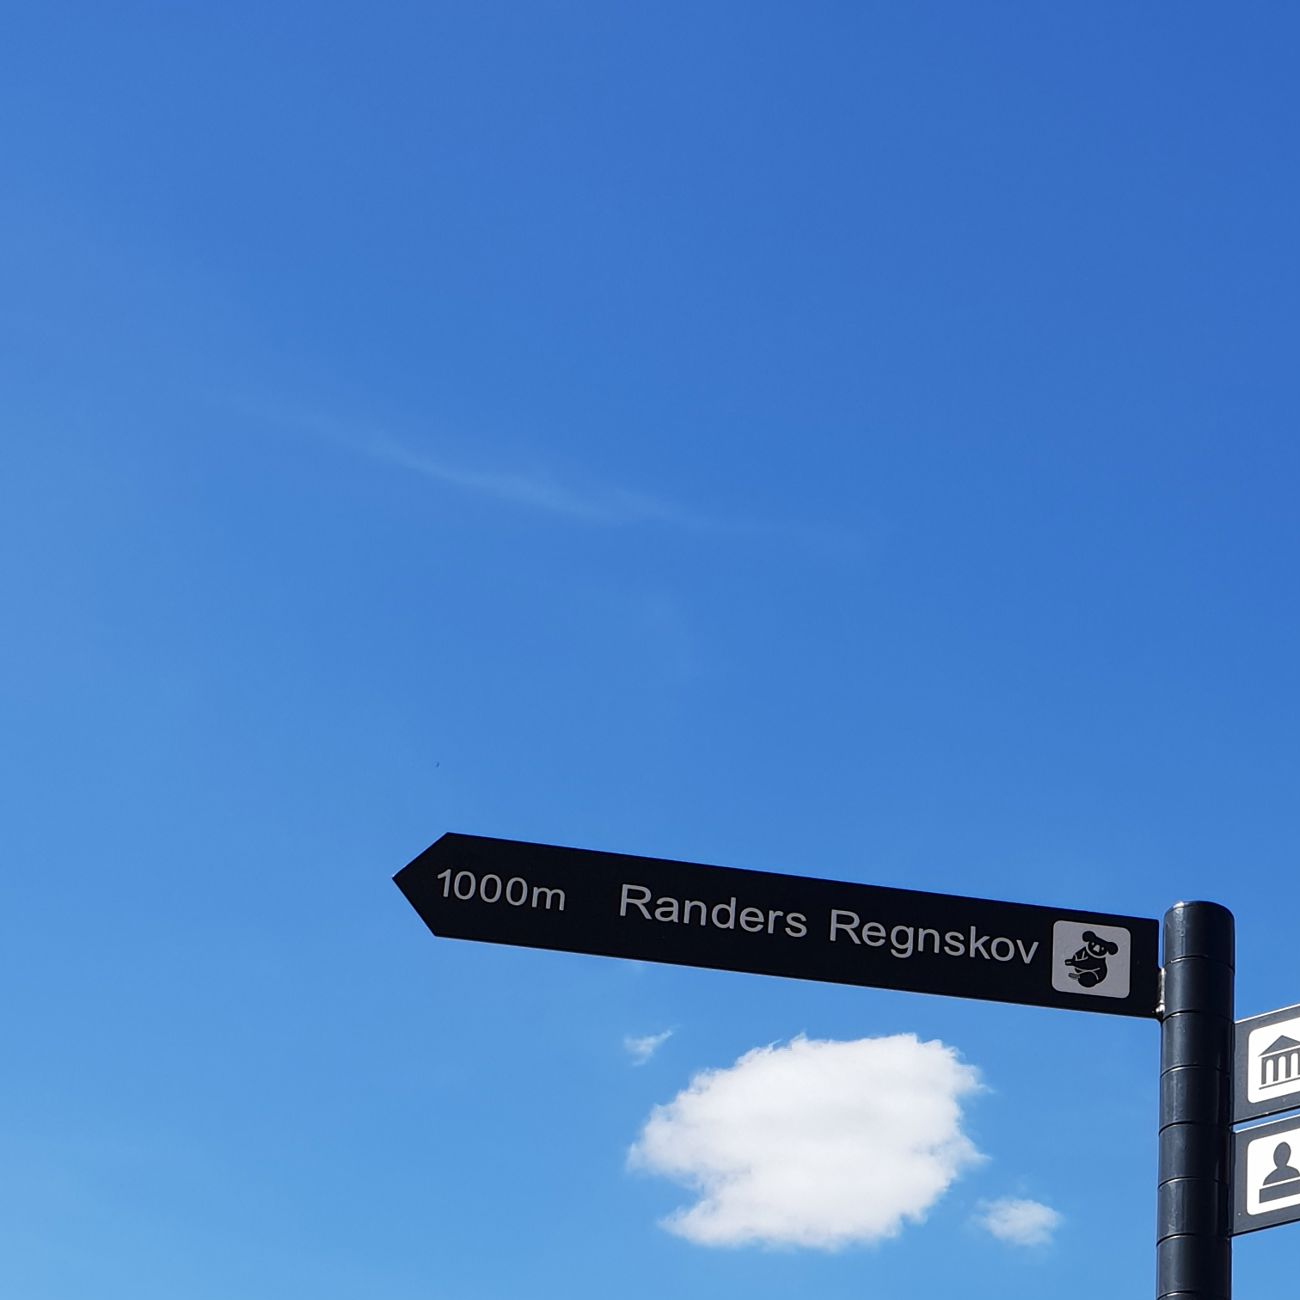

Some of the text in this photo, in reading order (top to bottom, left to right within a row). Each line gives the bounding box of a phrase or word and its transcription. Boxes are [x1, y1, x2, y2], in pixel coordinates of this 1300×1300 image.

[437, 869, 1039, 964] 1000m Randers Regnskov
